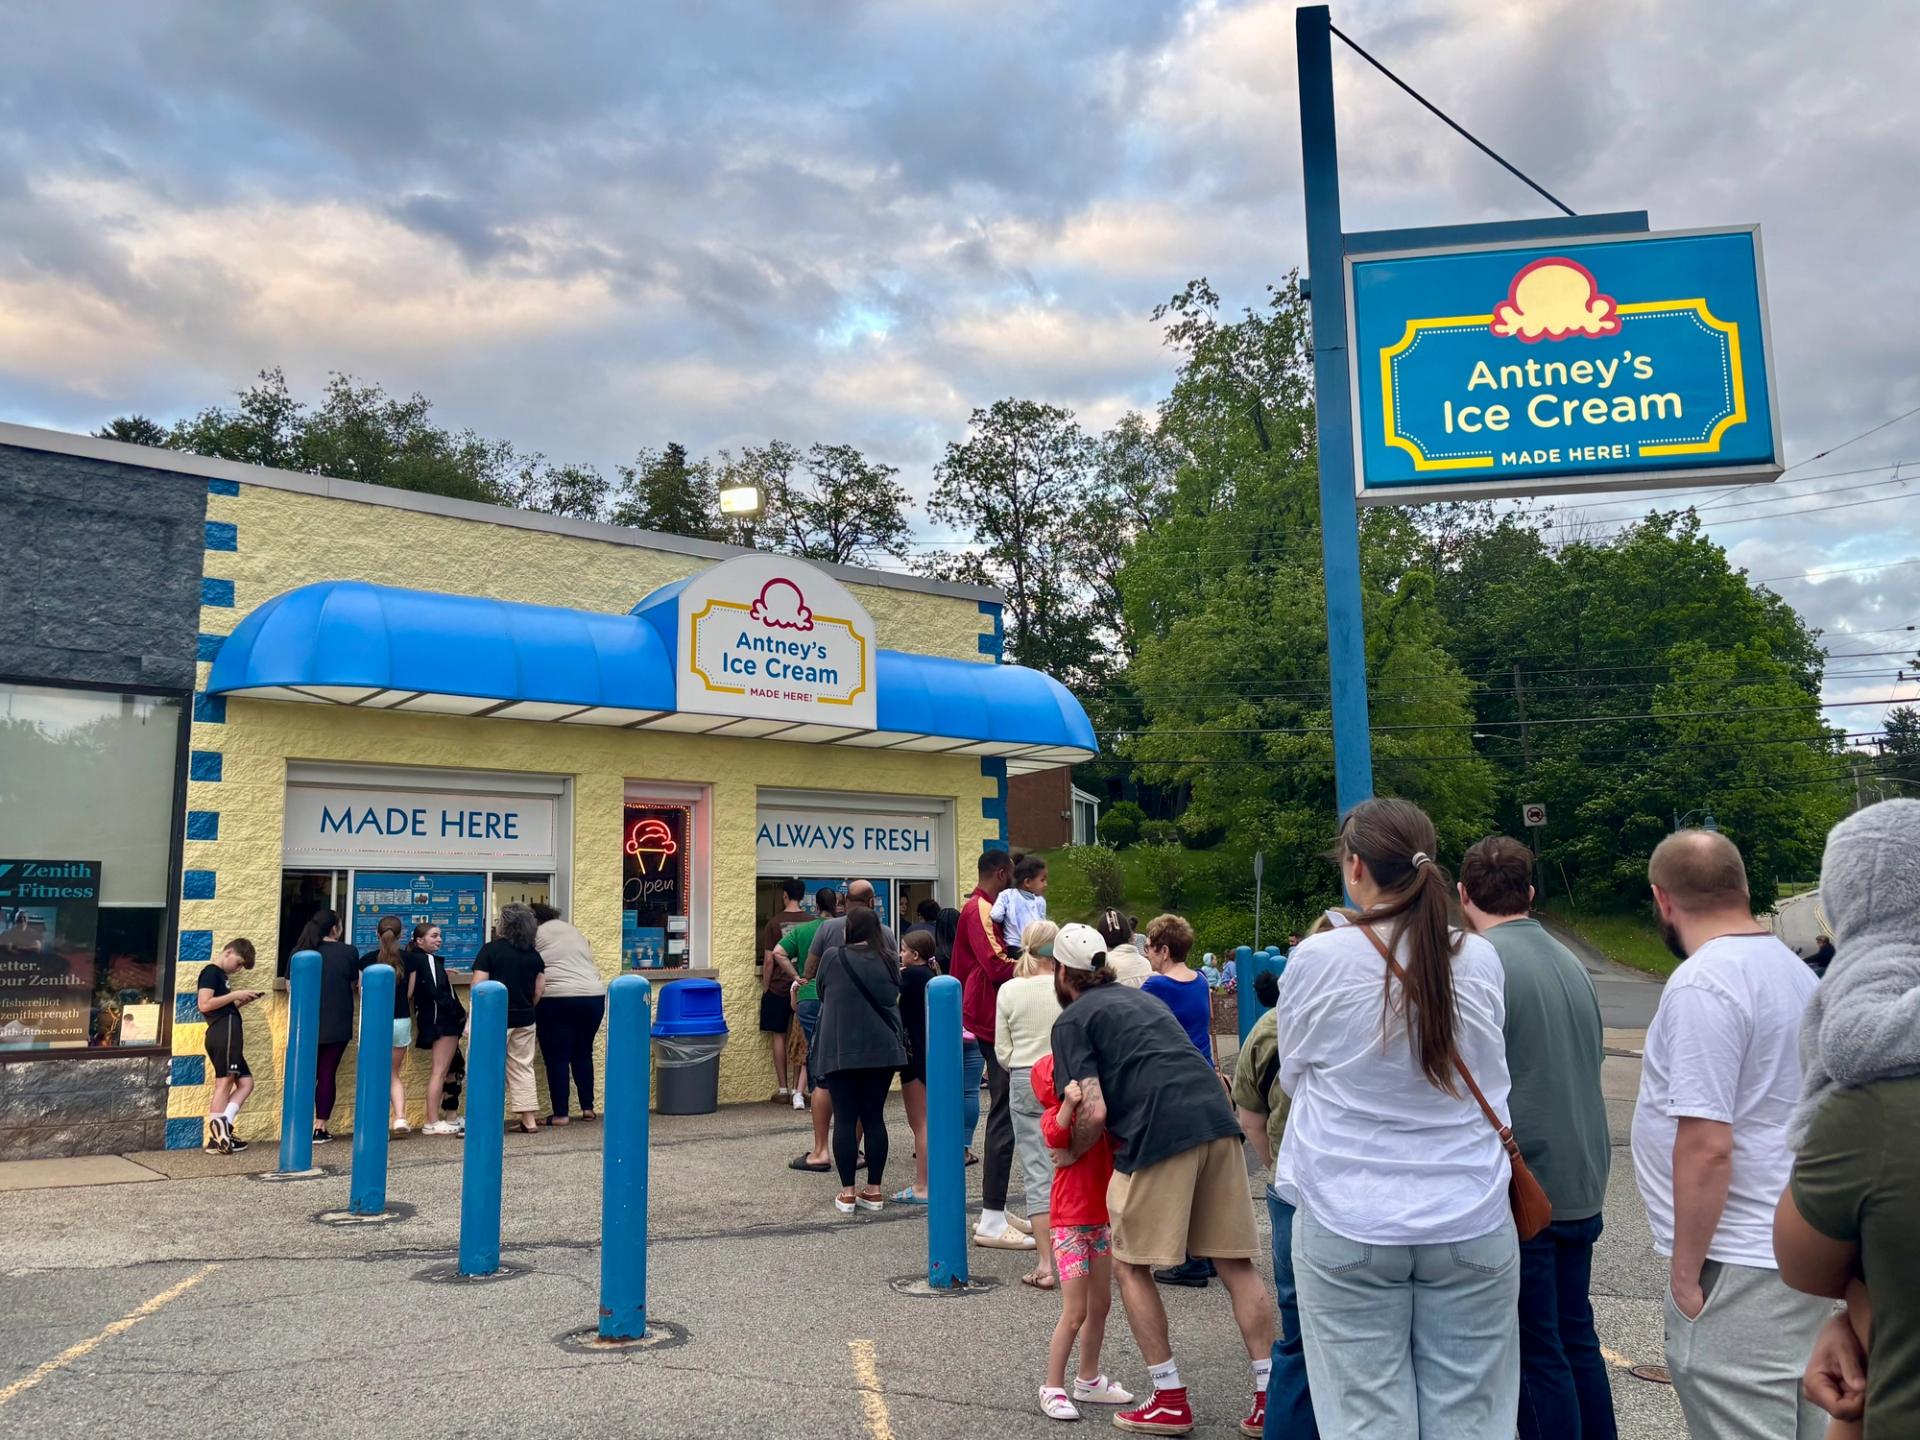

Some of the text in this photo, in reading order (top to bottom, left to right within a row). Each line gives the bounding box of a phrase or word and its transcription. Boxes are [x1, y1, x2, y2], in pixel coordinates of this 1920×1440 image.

[1466, 350, 1654, 392] Antney's
[1443, 391, 1683, 434] Ice Cream
[1501, 443, 1631, 466] MADE HERE!
[736, 631, 827, 660] Antney's
[723, 652, 838, 685] Ice Cream
[750, 688, 813, 702] MADE HERE!
[320, 805, 519, 839] MADE HERE
[756, 823, 929, 852] ALWAYS FRESH
[22, 863, 92, 878] Zenith
[17, 883, 94, 898] Fitness
[623, 877, 674, 902] Open
[0, 961, 40, 972] etter.
[0, 973, 86, 987] our Zenith.
